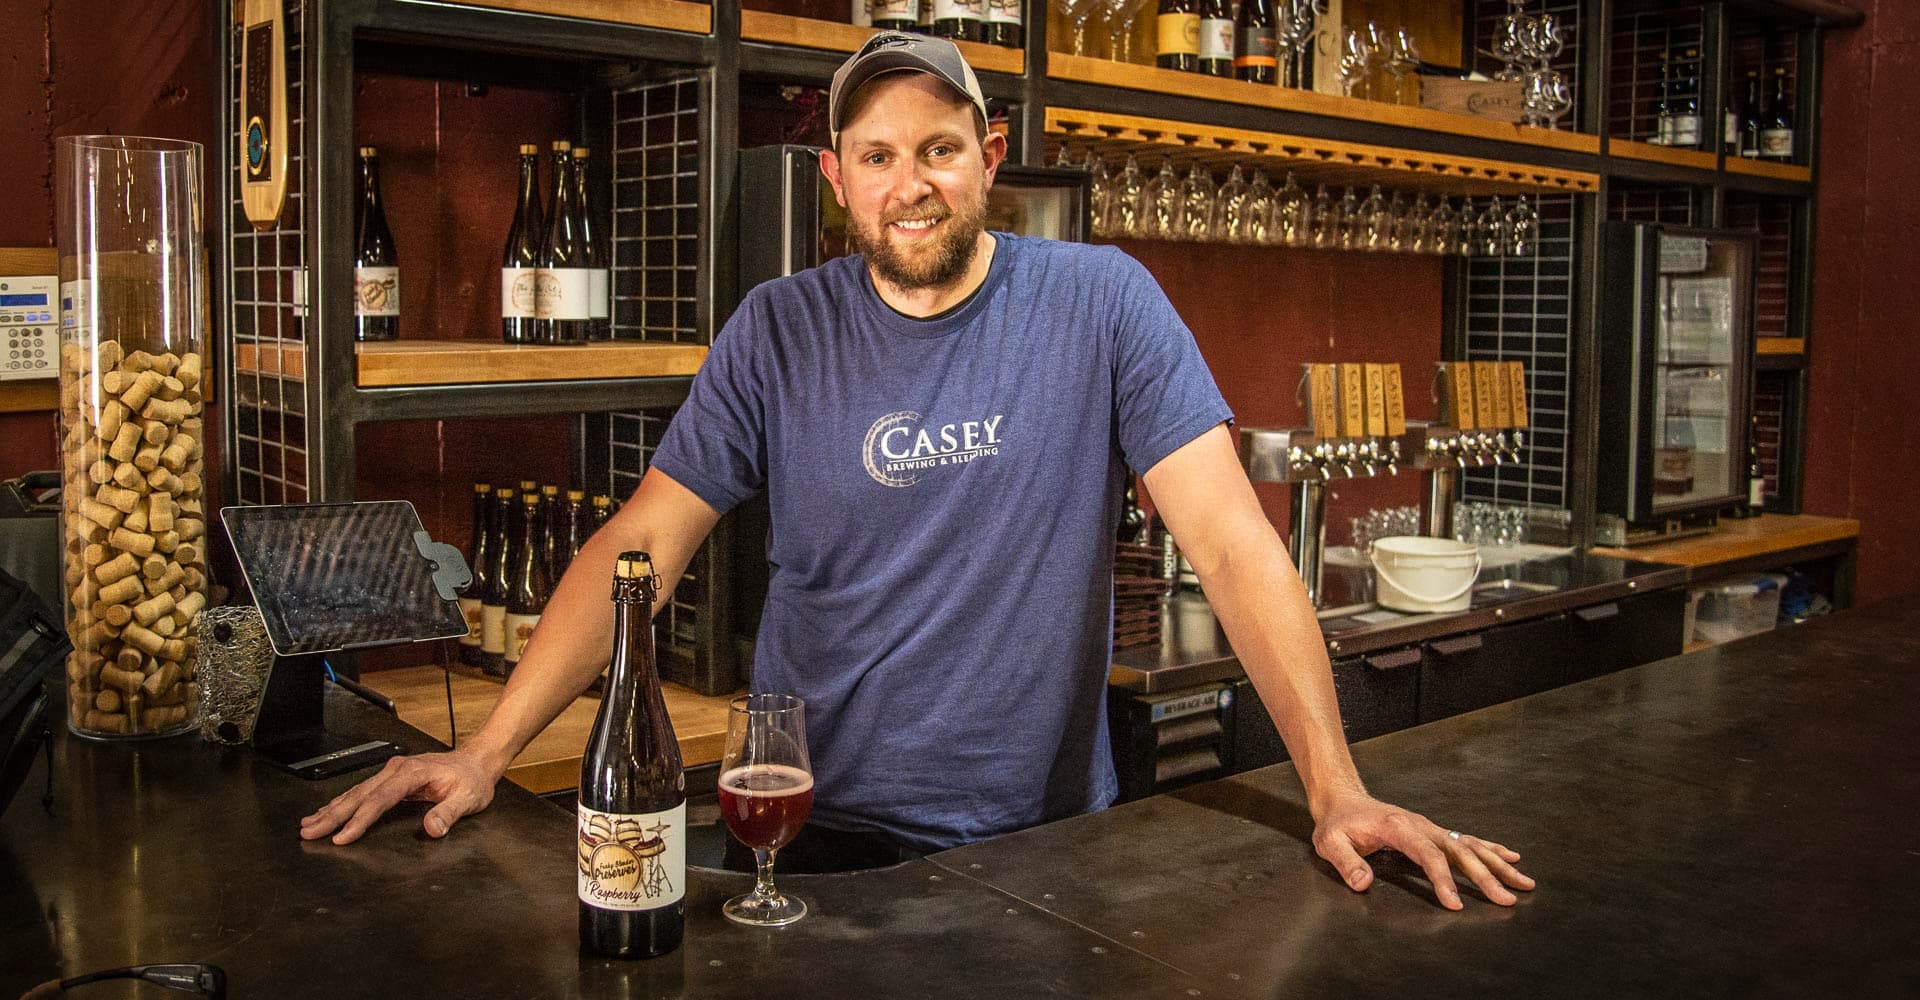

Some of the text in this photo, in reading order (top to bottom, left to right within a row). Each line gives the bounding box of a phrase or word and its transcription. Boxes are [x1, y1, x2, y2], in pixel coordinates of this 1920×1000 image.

[1350, 369, 1359, 419] CASEY
[1371, 369, 1380, 418] CASEY
[1390, 369, 1400, 418] CASEY
[1461, 367, 1470, 413] CASEY
[1480, 366, 1489, 412] CASEY
[1514, 366, 1523, 411] CASEY
[886, 460, 936, 472] BREWING
[940, 457, 949, 465] &
[589, 881, 641, 903] Raspberry
[595, 864, 638, 881] Preserves
